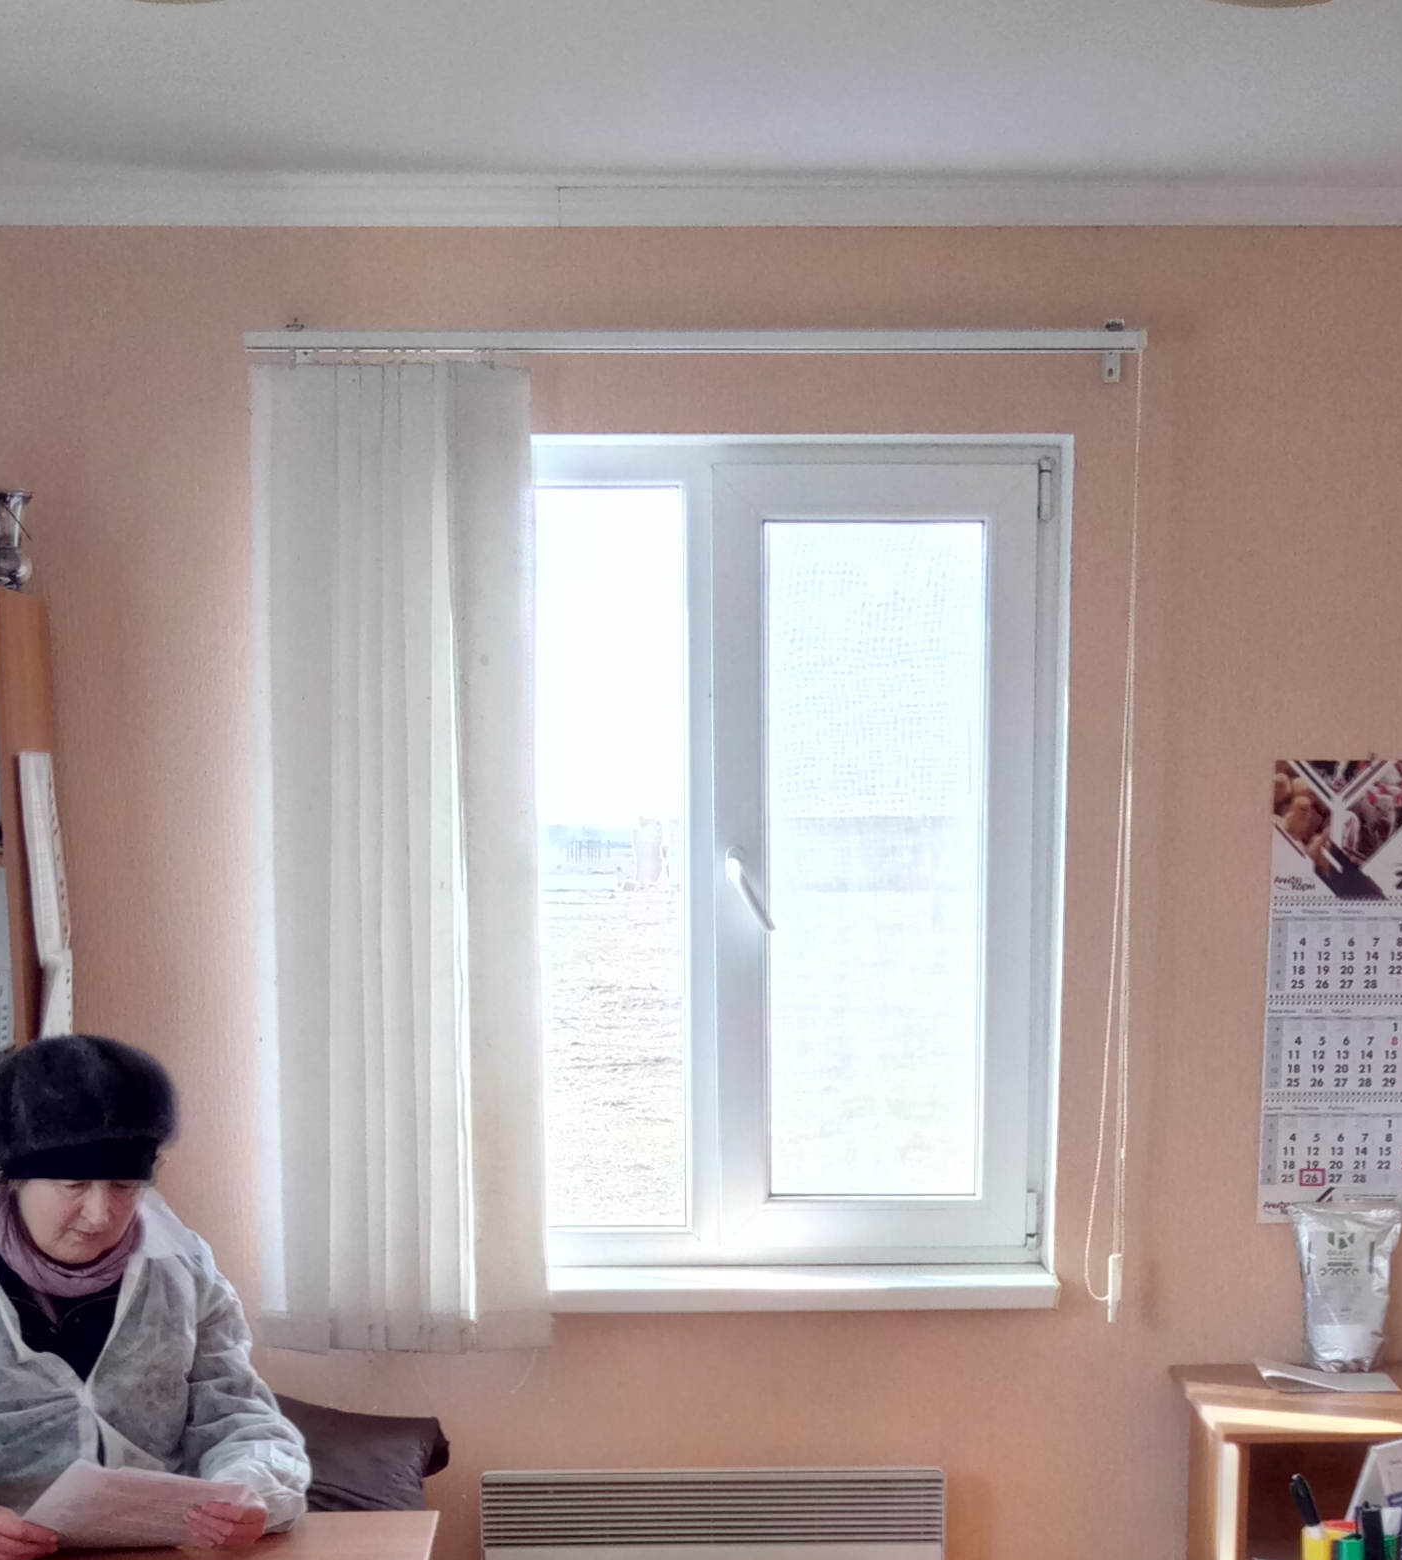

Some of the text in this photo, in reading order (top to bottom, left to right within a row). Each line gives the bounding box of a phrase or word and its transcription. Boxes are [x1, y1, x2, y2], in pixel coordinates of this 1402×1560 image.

[1292, 951, 1305, 961] 11
[1317, 951, 1331, 961] 12
[1341, 951, 1355, 961] 13
[1366, 951, 1380, 960] 14
[1292, 965, 1306, 975] 18
[1316, 965, 1330, 975] 19
[1340, 965, 1355, 975] 20
[1364, 965, 1378, 975] 21
[1388, 965, 1402, 975] 22
[1290, 979, 1378, 989] 25 26 27 28
[1288, 1049, 1300, 1059] 11
[1312, 1049, 1326, 1059] 12
[1336, 1049, 1350, 1059] 13
[1360, 1049, 1374, 1059] 14
[1384, 1050, 1398, 1060] 15
[1287, 1063, 1301, 1073] 18
[1311, 1063, 1325, 1073] 19
[1334, 1063, 1350, 1073] 20
[1358, 1063, 1372, 1073] 21
[1382, 1063, 1397, 1073] 22
[1286, 1077, 1301, 1087] 25
[1309, 1077, 1325, 1087] 26
[1333, 1077, 1349, 1087] 27
[1358, 1077, 1373, 1087] 28
[1382, 1077, 1397, 1087] 29
[1282, 1146, 1295, 1156] 11
[1306, 1146, 1321, 1156] 12
[1330, 1146, 1344, 1156] 13
[1355, 1146, 1368, 1155] 14
[1378, 1146, 1392, 1156] 15
[1282, 1159, 1296, 1169] 18
[1328, 1159, 1344, 1169] 20
[1352, 1159, 1367, 1169] 21
[1376, 1159, 1391, 1169] 22
[1280, 1173, 1367, 1183] 25 26 27 28
